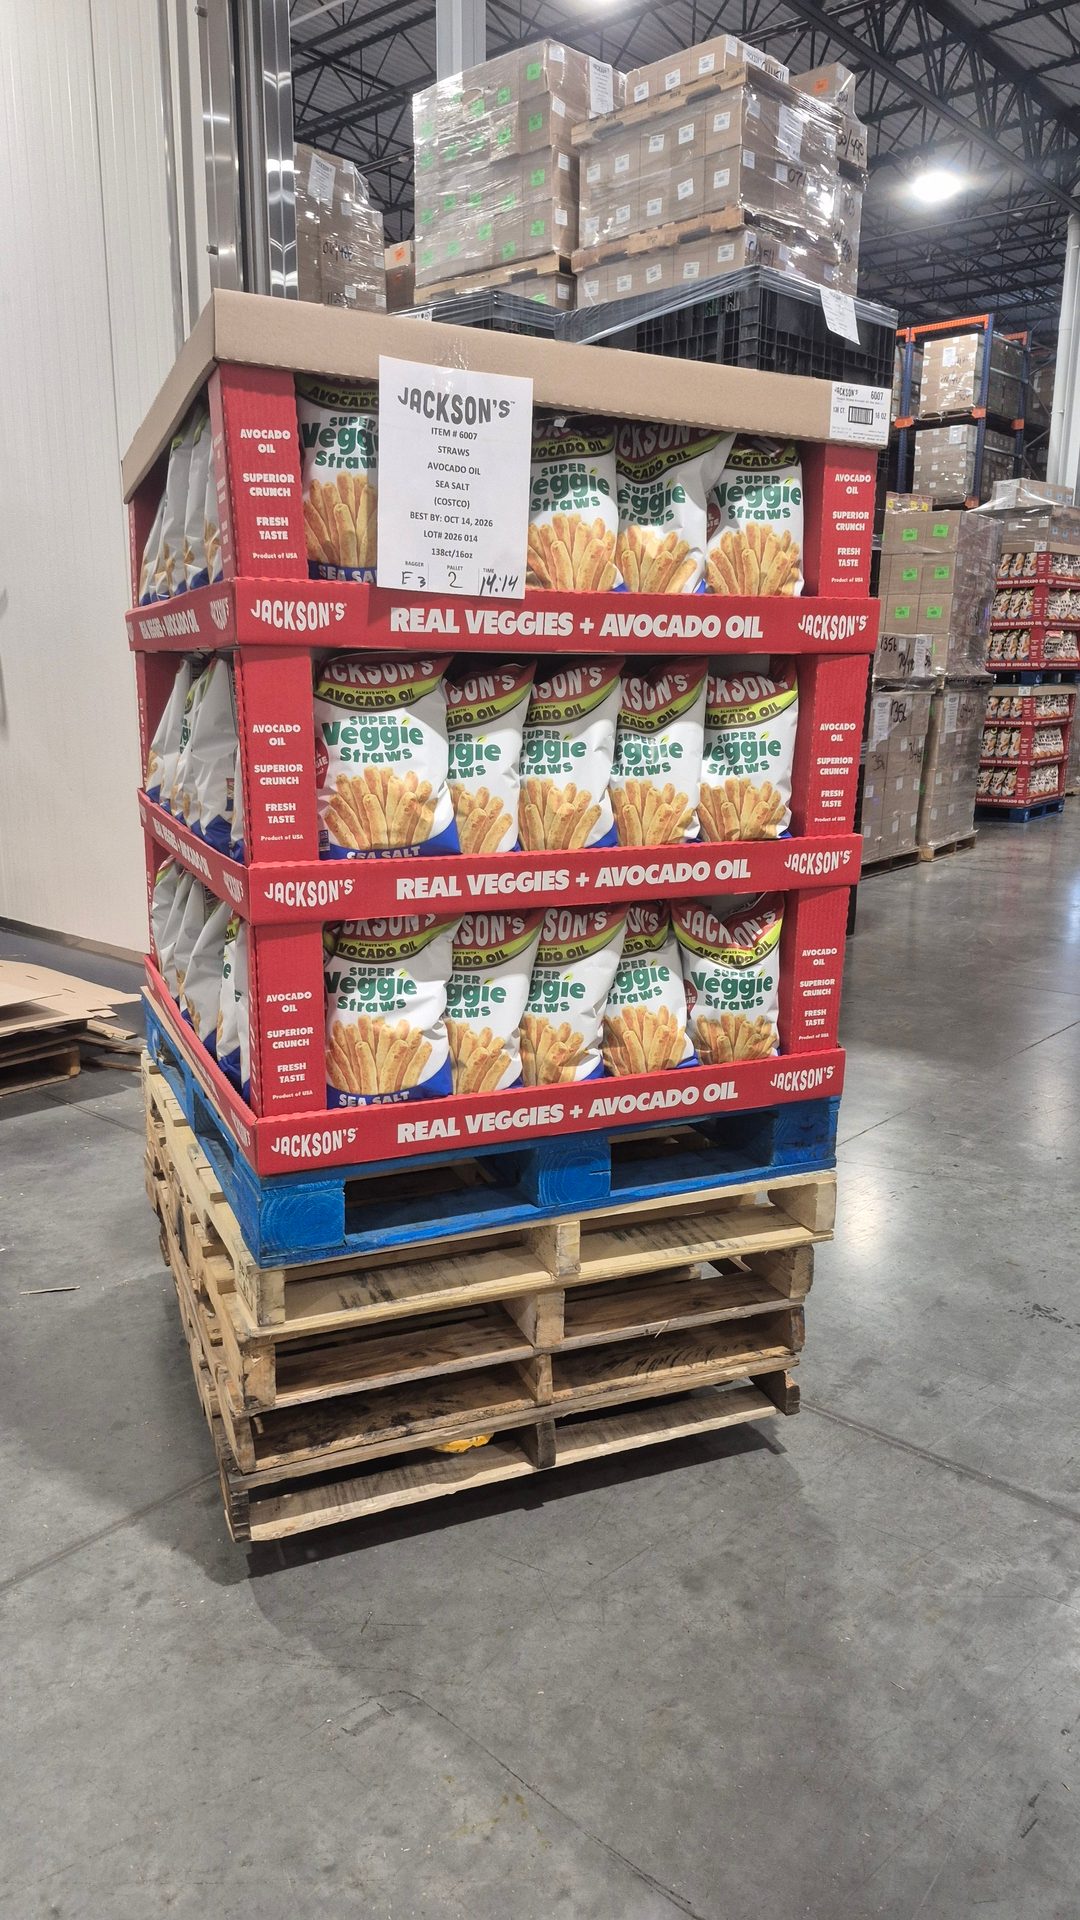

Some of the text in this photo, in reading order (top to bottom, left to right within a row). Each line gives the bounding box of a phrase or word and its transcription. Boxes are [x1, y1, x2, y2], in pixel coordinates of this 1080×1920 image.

[871, 391, 883, 400] 6007
[397, 387, 512, 425] JACKSON'S
[330, 416, 376, 431] SUPER
[240, 429, 291, 440] AVOCADO
[431, 427, 450, 437] ITEM
[459, 431, 477, 440] 6007
[258, 444, 276, 454] OIL
[438, 446, 470, 456] STRAWS
[588, 440, 606, 452] OIL
[666, 450, 691, 463] OIL
[427, 462, 480, 475] AVOCADO OIL
[541, 463, 586, 476] SUPER
[243, 473, 295, 484] SUPERIOR
[736, 475, 780, 484] SUPER
[835, 474, 871, 483] AVOCADO
[435, 480, 470, 491] SEA SALT
[625, 482, 663, 495] SUPER
[846, 486, 858, 495] OIL
[249, 488, 291, 497] CRUNCH
[713, 482, 801, 508] Veggie
[434, 497, 470, 509] (COSTCO)
[531, 496, 600, 511] Straws
[728, 505, 790, 520] Straws
[832, 511, 869, 520] SUPERIOR
[256, 517, 288, 527] FRESH
[410, 511, 493, 527] BEST BY: OCT 14, 2026
[836, 522, 865, 531] CRUNCH
[259, 530, 288, 540] TASTE
[423, 530, 478, 542] LOT# 2026 014
[432, 548, 473, 559] 138ct/16oz
[837, 548, 861, 556] FRESH
[838, 559, 859, 567] TASTE
[448, 572, 463, 588] 2
[251, 599, 345, 632] JACKSON'S
[390, 607, 763, 639] REAL VEGGIES + AVOCADO OIL
[798, 614, 866, 641] JACKSON'S
[324, 688, 396, 706] AVOCADO
[477, 705, 500, 719] OIL
[564, 704, 586, 717] OIL
[657, 708, 678, 723] OIL
[759, 702, 782, 717] OIL
[349, 716, 397, 725] SUPER
[253, 724, 301, 733] AVOCADO
[820, 723, 856, 731] AVOCADO
[269, 738, 286, 746] OIL
[321, 721, 424, 751] Veggie
[717, 732, 756, 744] SUPER
[340, 747, 412, 763] Straws
[254, 764, 303, 773] SUPERIOR
[610, 762, 671, 776] Straws
[707, 760, 770, 775] Straws
[260, 776, 299, 786] CRUNCH
[265, 803, 296, 812] FRESH
[268, 815, 295, 824] TASTE
[784, 850, 850, 876] JACKSON'S
[396, 859, 751, 900] REAL VEGGIES + AVOCADO OIL
[264, 879, 353, 907] JACKSON'S
[682, 910, 776, 947] JACKON'S
[400, 941, 417, 954] OIL
[566, 945, 589, 958] OIL
[695, 940, 772, 965] AVOCADO OIL
[802, 948, 837, 957] AVOCADO
[486, 950, 508, 963] OIL
[813, 958, 825, 966] OIL
[349, 967, 395, 976] SUPER
[714, 969, 755, 978] SUPER
[324, 972, 417, 1001] Veggie
[691, 971, 773, 1000] Veggie
[800, 978, 835, 987] SUPERIOR
[266, 991, 312, 1003] AVOCADO
[802, 988, 831, 997] CRUNCH
[337, 996, 406, 1012] Straws
[705, 994, 764, 1010] Straws
[282, 1004, 297, 1013] OIL
[804, 1009, 826, 1017] FRESH
[805, 1018, 825, 1026] TASTE
[267, 1026, 314, 1039] SUPERIOR
[272, 1038, 309, 1049] CRUNCH
[277, 1063, 306, 1073] FRESH
[279, 1073, 305, 1084] TASTE
[770, 1065, 833, 1092] JACKSON'S
[339, 1091, 409, 1107] SEA SALT
[397, 1081, 738, 1144] REAL VEGGIES + AVOCADO OIL
[271, 1128, 356, 1158] JACKSON'S
